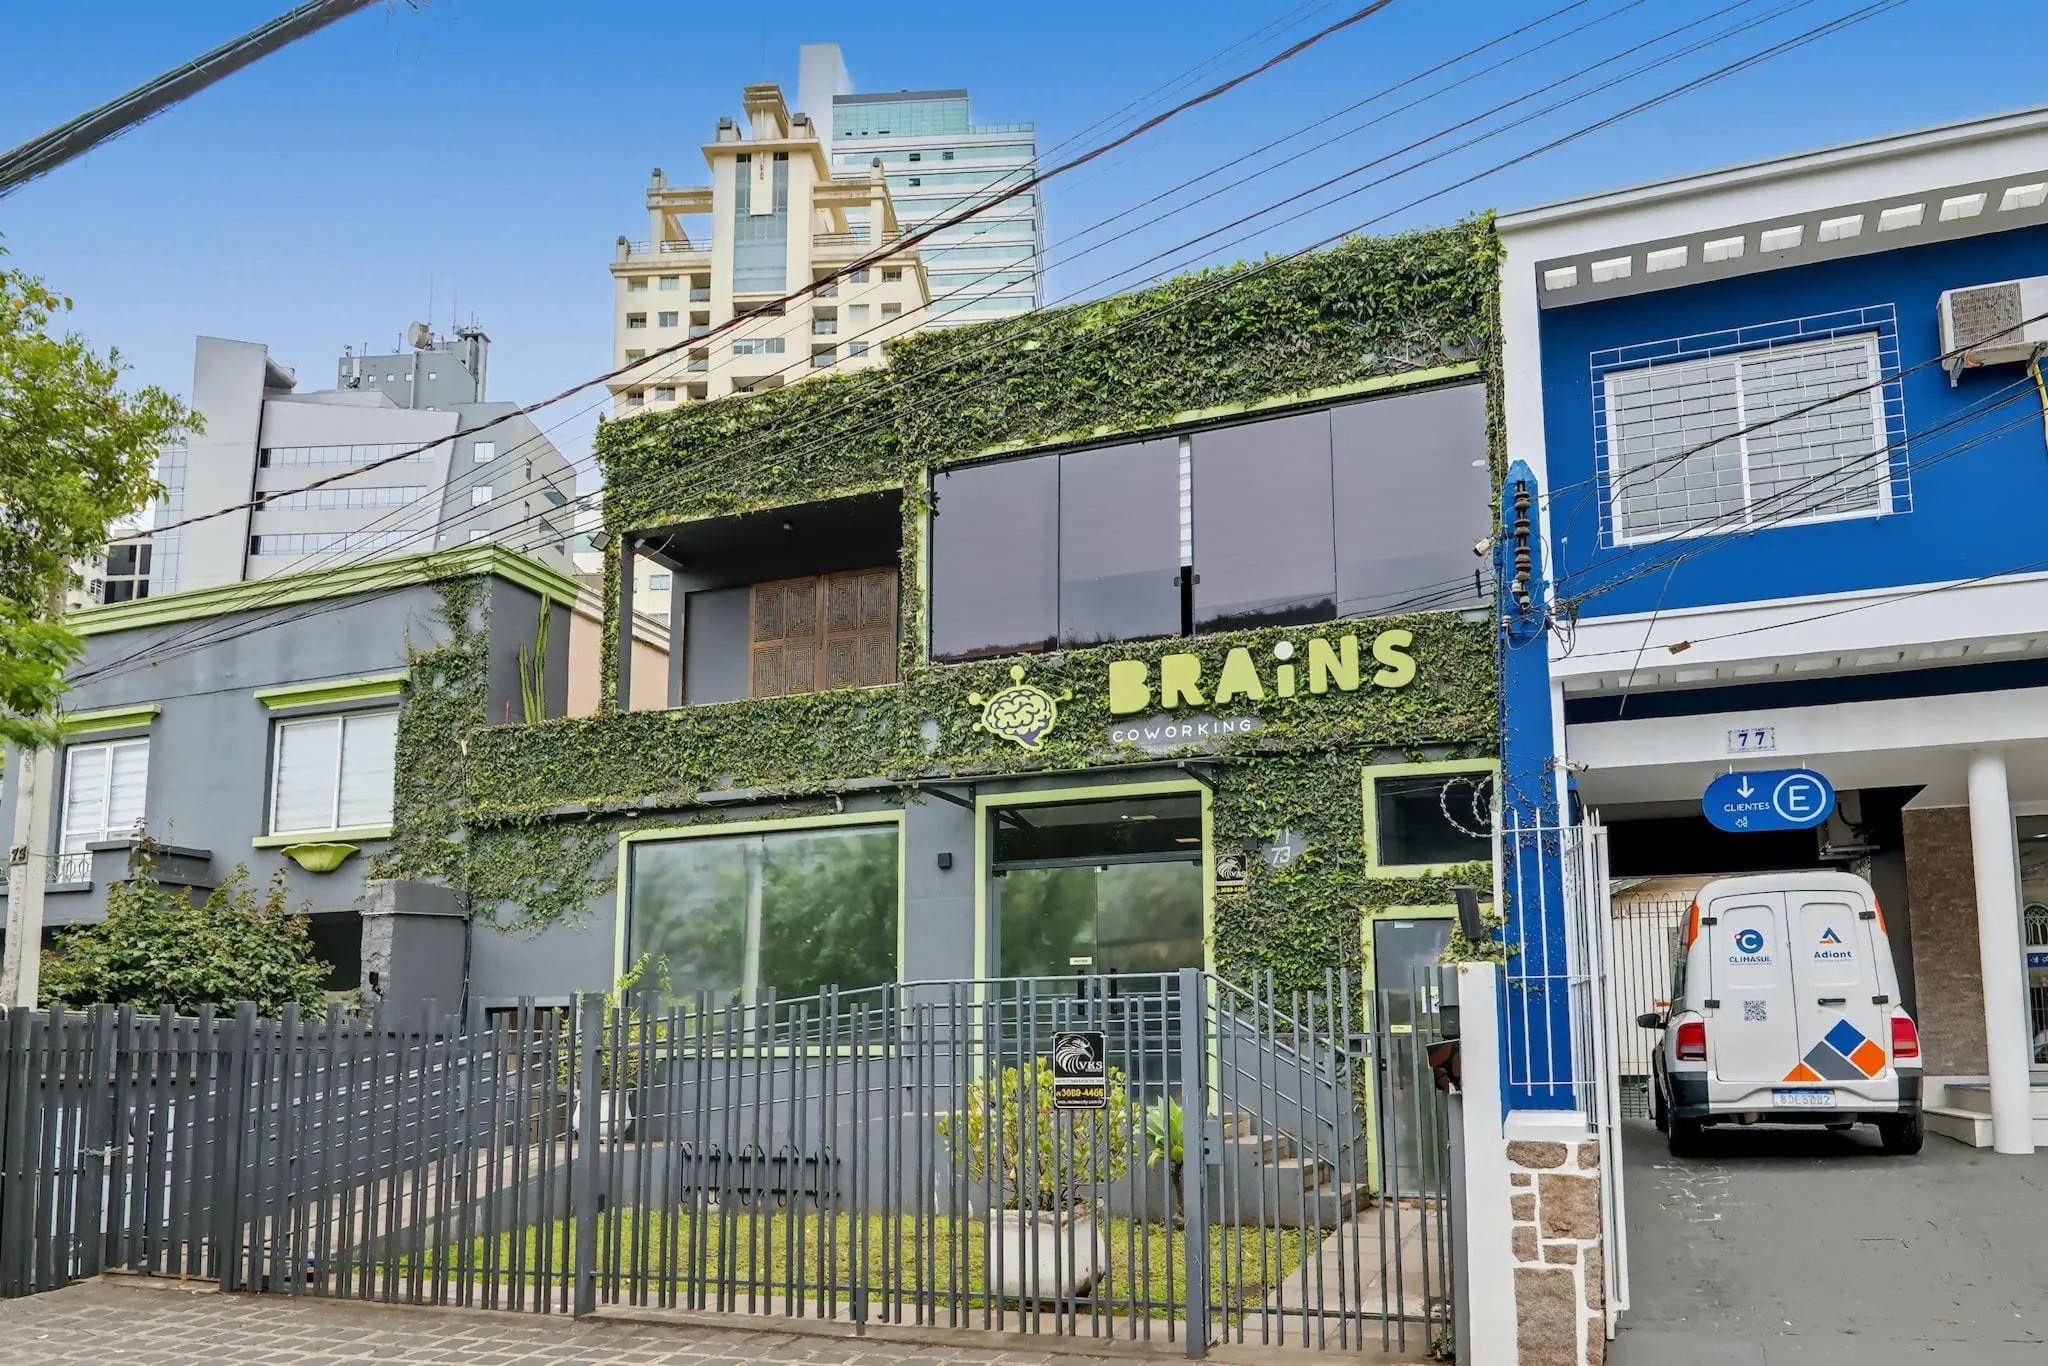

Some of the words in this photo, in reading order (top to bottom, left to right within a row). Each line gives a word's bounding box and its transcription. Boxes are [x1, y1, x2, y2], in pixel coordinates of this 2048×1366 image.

[1112, 719, 1252, 743] COWORKING
[1789, 785, 1811, 811] E
[1723, 801, 1770, 812] CLIENTES
[1271, 846, 1291, 867] 73
[1729, 955, 1772, 963] CLIMASUL
[1814, 951, 1852, 959] Adiant
[1078, 1061, 1103, 1070] VKS
